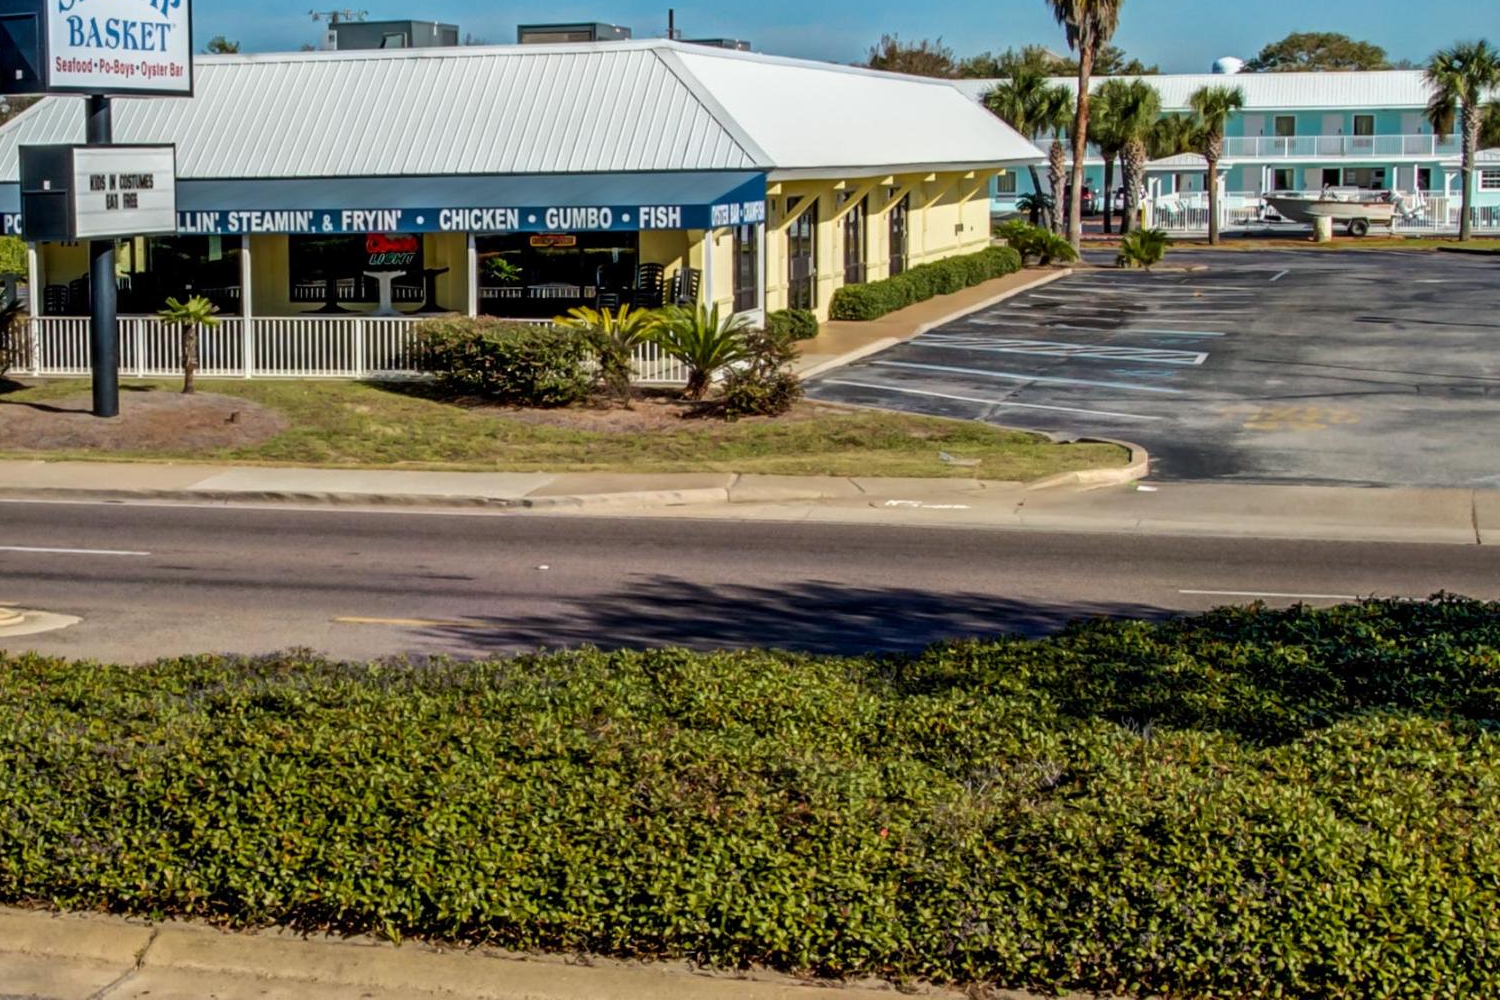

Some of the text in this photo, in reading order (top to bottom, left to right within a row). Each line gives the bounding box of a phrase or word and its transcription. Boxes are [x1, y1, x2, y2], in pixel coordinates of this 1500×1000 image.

[66, 14, 171, 52] BASKET
[55, 55, 184, 79] Seafood Po-Boys Oyster Bar
[89, 173, 154, 191] KIDS IN COSTUMES
[106, 192, 138, 210] EAT FREE
[323, 213, 334, 232] &
[342, 210, 402, 231] FRYIN'
[439, 208, 519, 231] CHICKEN
[546, 207, 612, 230] GUMBO
[639, 206, 681, 229] FISH
